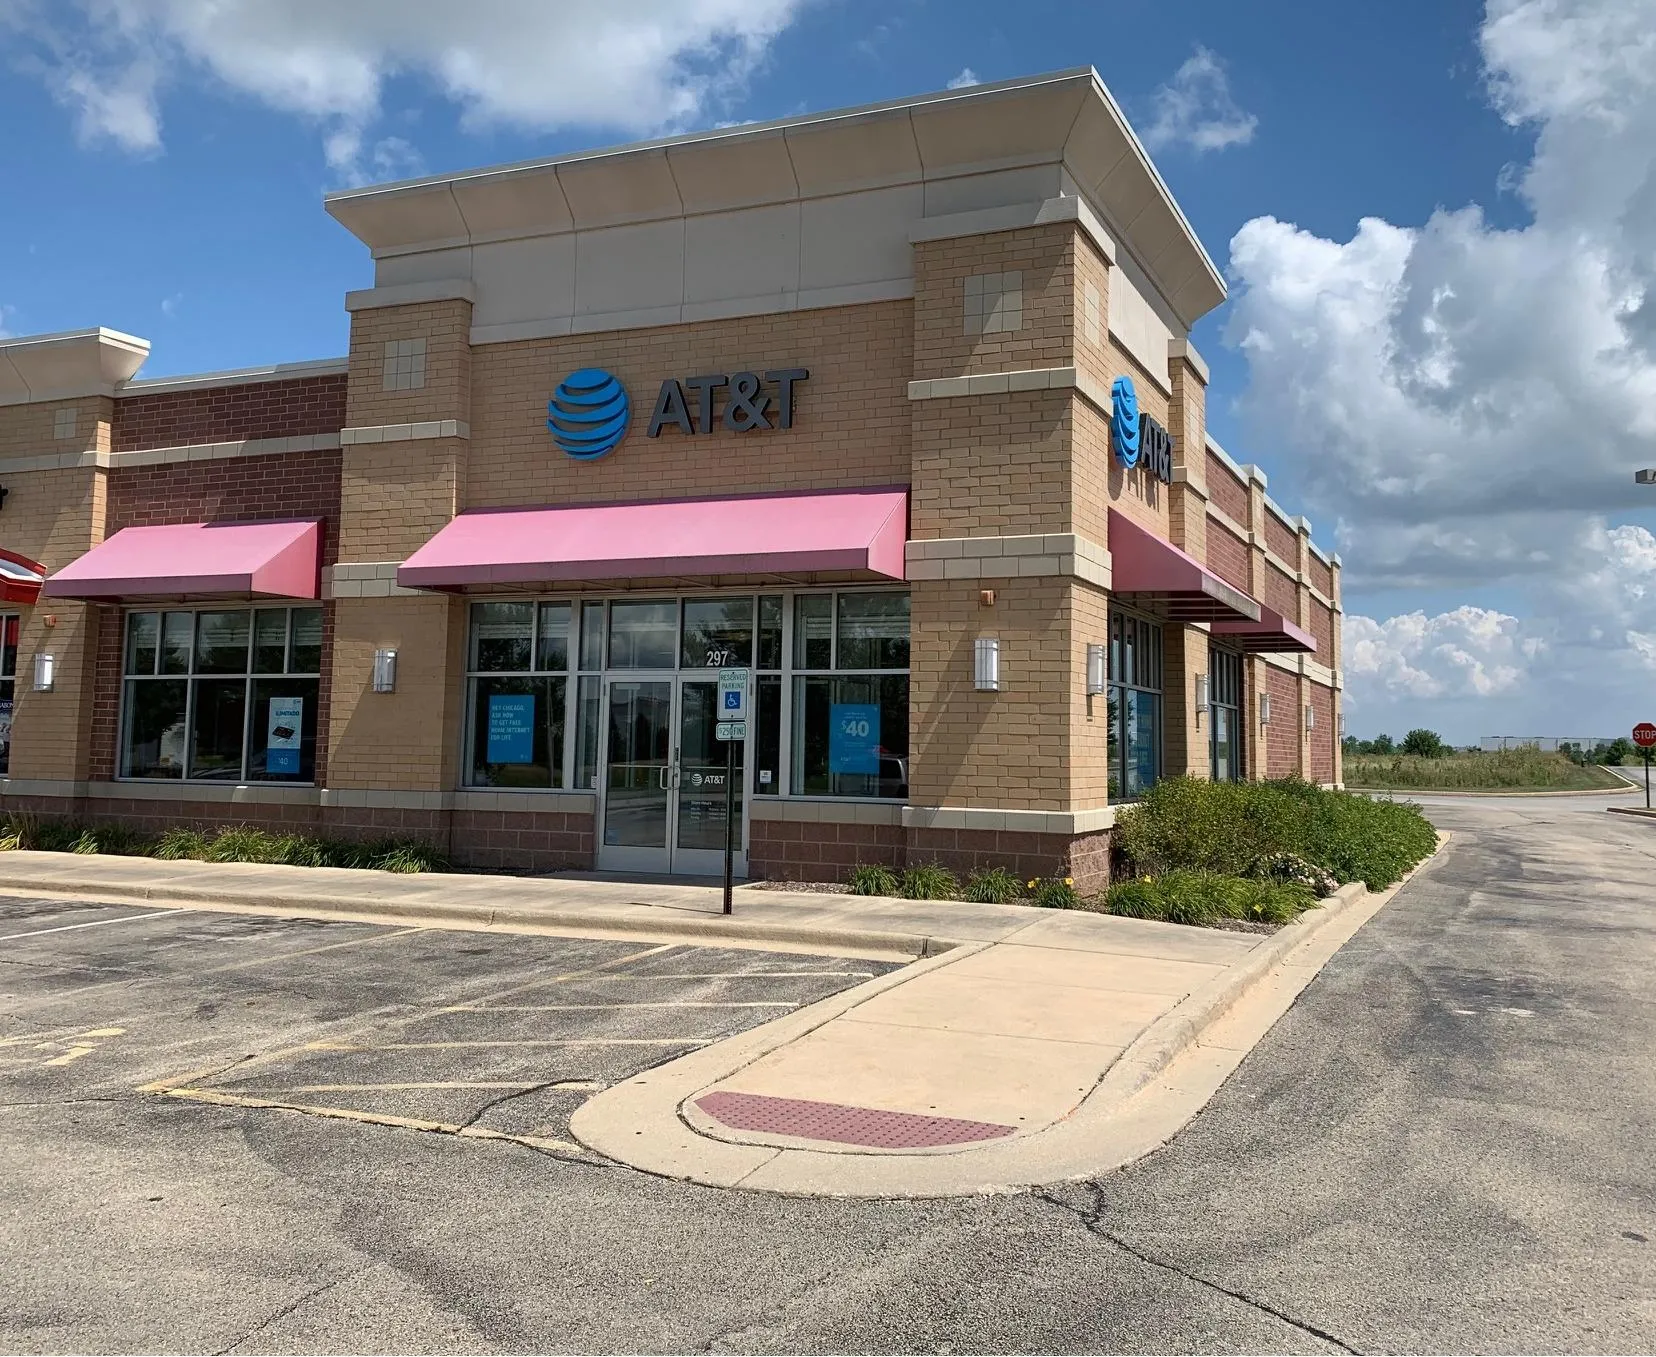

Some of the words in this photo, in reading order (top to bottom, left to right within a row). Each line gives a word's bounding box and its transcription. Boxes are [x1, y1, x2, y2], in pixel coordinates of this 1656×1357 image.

[647, 368, 809, 438] AT&T
[706, 650, 729, 666] 297
[720, 673, 747, 681] RESERVED
[733, 726, 745, 736] FINE
[1634, 730, 1656, 740] STOP
[704, 775, 725, 785] AT&T
